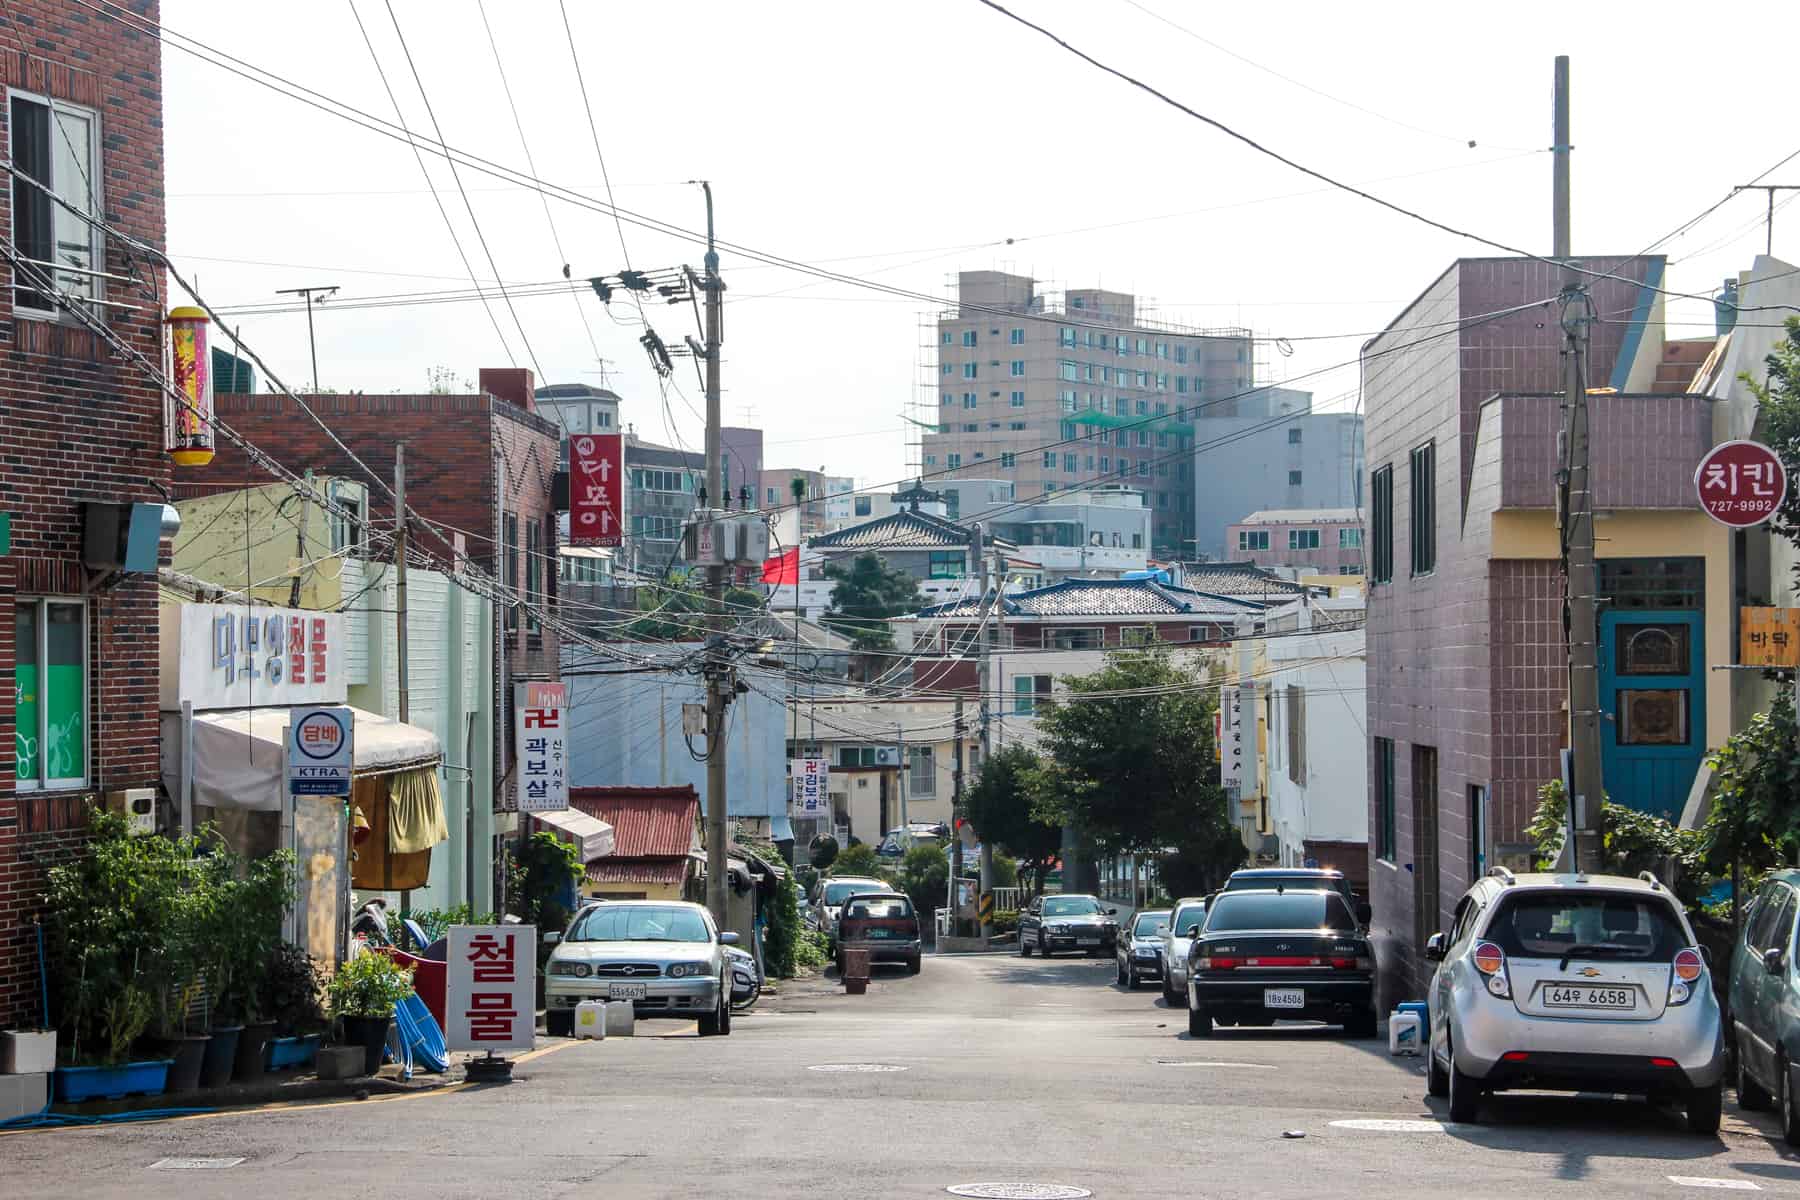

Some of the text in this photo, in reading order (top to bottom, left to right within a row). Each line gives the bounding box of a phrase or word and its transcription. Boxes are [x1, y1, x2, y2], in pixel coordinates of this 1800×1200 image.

[578, 458, 613, 534] 다모아
[1705, 462, 1774, 496] 치킨
[1711, 500, 1772, 512] 727-9992
[304, 725, 338, 743] 담배
[299, 767, 339, 777] KTRA
[525, 737, 549, 798] 곽보살
[805, 774, 817, 810] 김보살
[465, 934, 518, 1041] 철물
[1552, 988, 1626, 1005] 64우 6658
